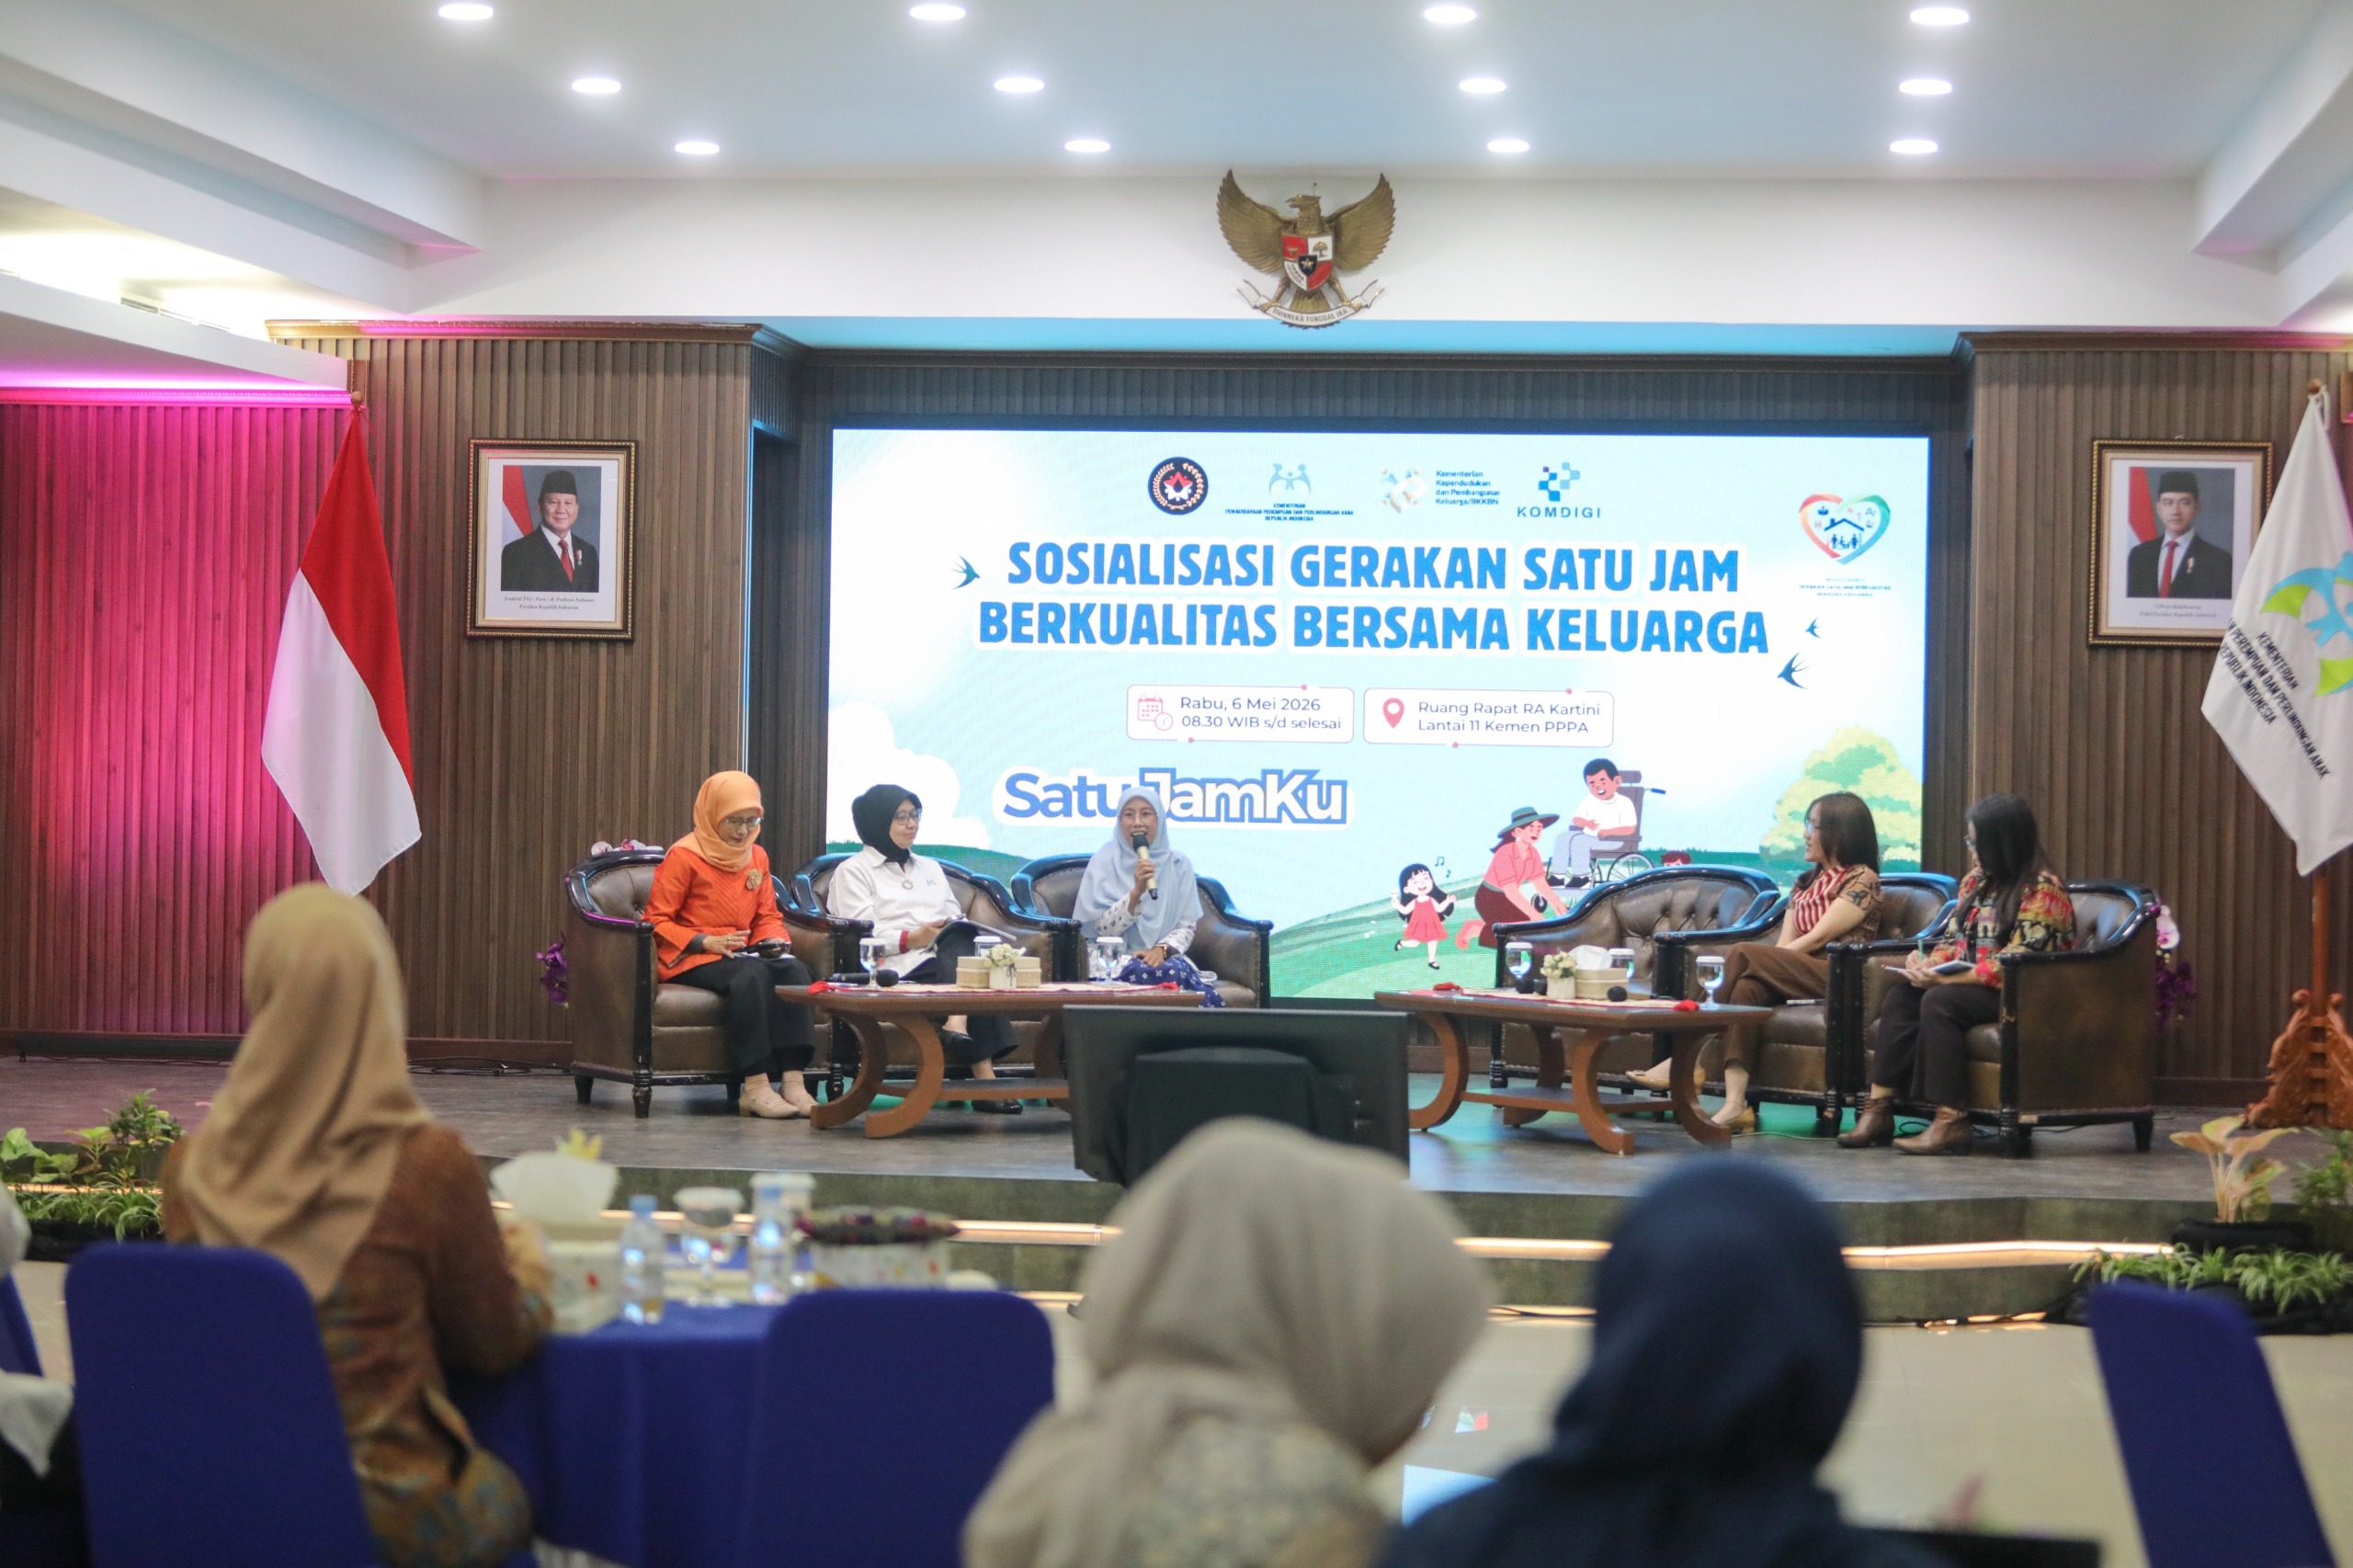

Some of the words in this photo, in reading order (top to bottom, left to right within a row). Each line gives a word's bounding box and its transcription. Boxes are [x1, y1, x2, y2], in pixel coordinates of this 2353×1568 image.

[1272, 307, 1304, 323] BHINNEKA
[1305, 313, 1336, 323] TUNGGAL
[1336, 308, 1347, 318] IKA
[1436, 470, 1483, 478] Kementerian
[1436, 479, 1491, 488] Kependudukan
[1450, 489, 1501, 497] Pembangunan
[1436, 497, 1499, 506] Keluarga/BKKBN
[1517, 506, 1601, 518] KOMDIGI
[1007, 541, 1274, 586] SOSIALISASI
[1290, 544, 1506, 590] GERAKAN
[1523, 547, 1633, 592] SATU
[1649, 549, 1738, 593] JAM
[979, 600, 1278, 648] BERKUALITAS
[1294, 604, 1511, 651] BERSAMA
[1527, 608, 1769, 654] KELUARGA
[2256, 631, 2299, 690] KEMENTERIAN
[2219, 642, 2248, 685] REPUBLIK
[2241, 678, 2277, 725] INDONESIA
[1180, 697, 1228, 712] Rabu,
[1233, 698, 1242, 710] 6
[1245, 697, 1277, 710] Mei
[1280, 698, 1322, 711] 2026
[1418, 701, 1470, 717] Ruang
[1473, 703, 1518, 718] Rapat
[1523, 704, 1546, 715] RA
[1550, 704, 1601, 716] Kartini
[2229, 628, 2268, 677] PEREMPUAN
[2262, 672, 2280, 695] DAN
[2273, 690, 2316, 756] PERLINDUNGAN
[2308, 751, 2331, 779] ANAK
[1181, 714, 1224, 728] 08.30
[1228, 715, 1260, 728] WIB
[1264, 715, 1288, 730] s/d
[1290, 717, 1341, 730] selesai
[1418, 718, 1466, 732] Lantai
[1469, 720, 1481, 732] 11
[1485, 721, 1540, 733] Kemen
[1545, 722, 1590, 734] PPPA
